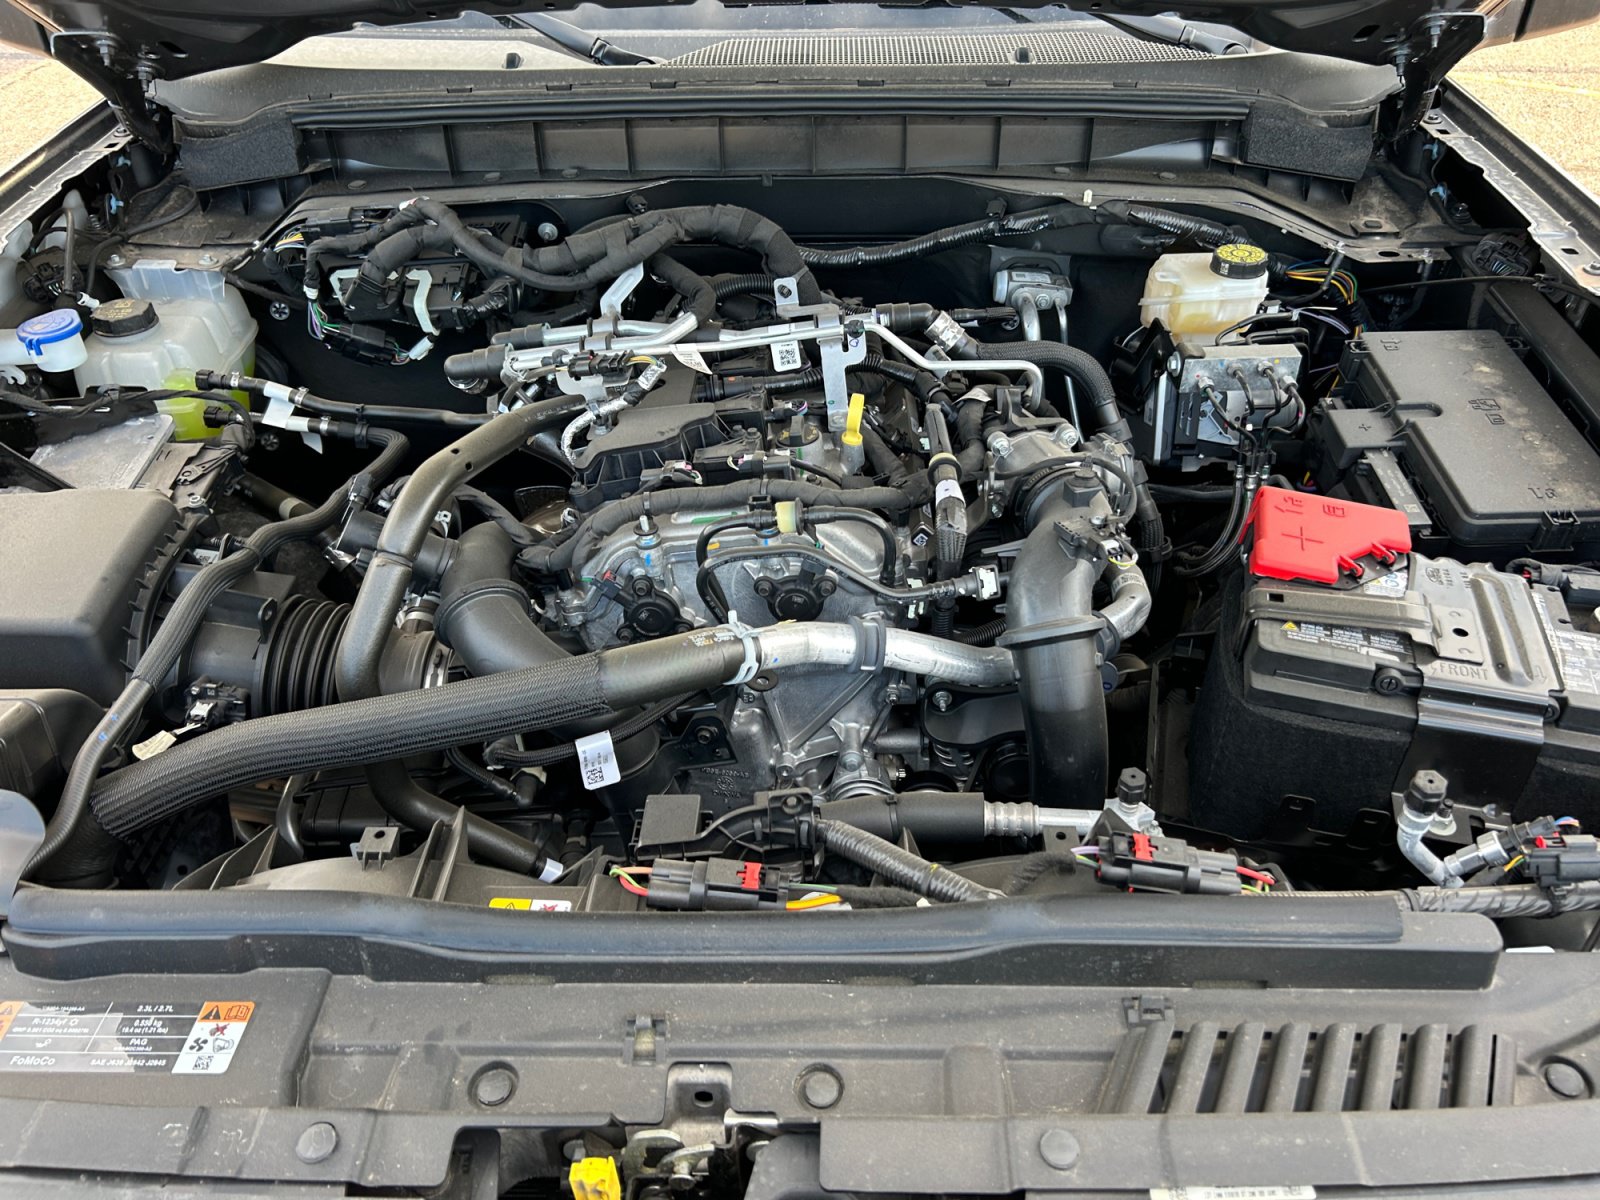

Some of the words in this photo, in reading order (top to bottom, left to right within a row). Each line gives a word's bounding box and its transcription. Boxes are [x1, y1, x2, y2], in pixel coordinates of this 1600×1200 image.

[1440, 663, 1488, 680] FRONT
[31, 1017, 68, 1027] R-1234yf
[9, 1055, 56, 1066] FoMoCo
